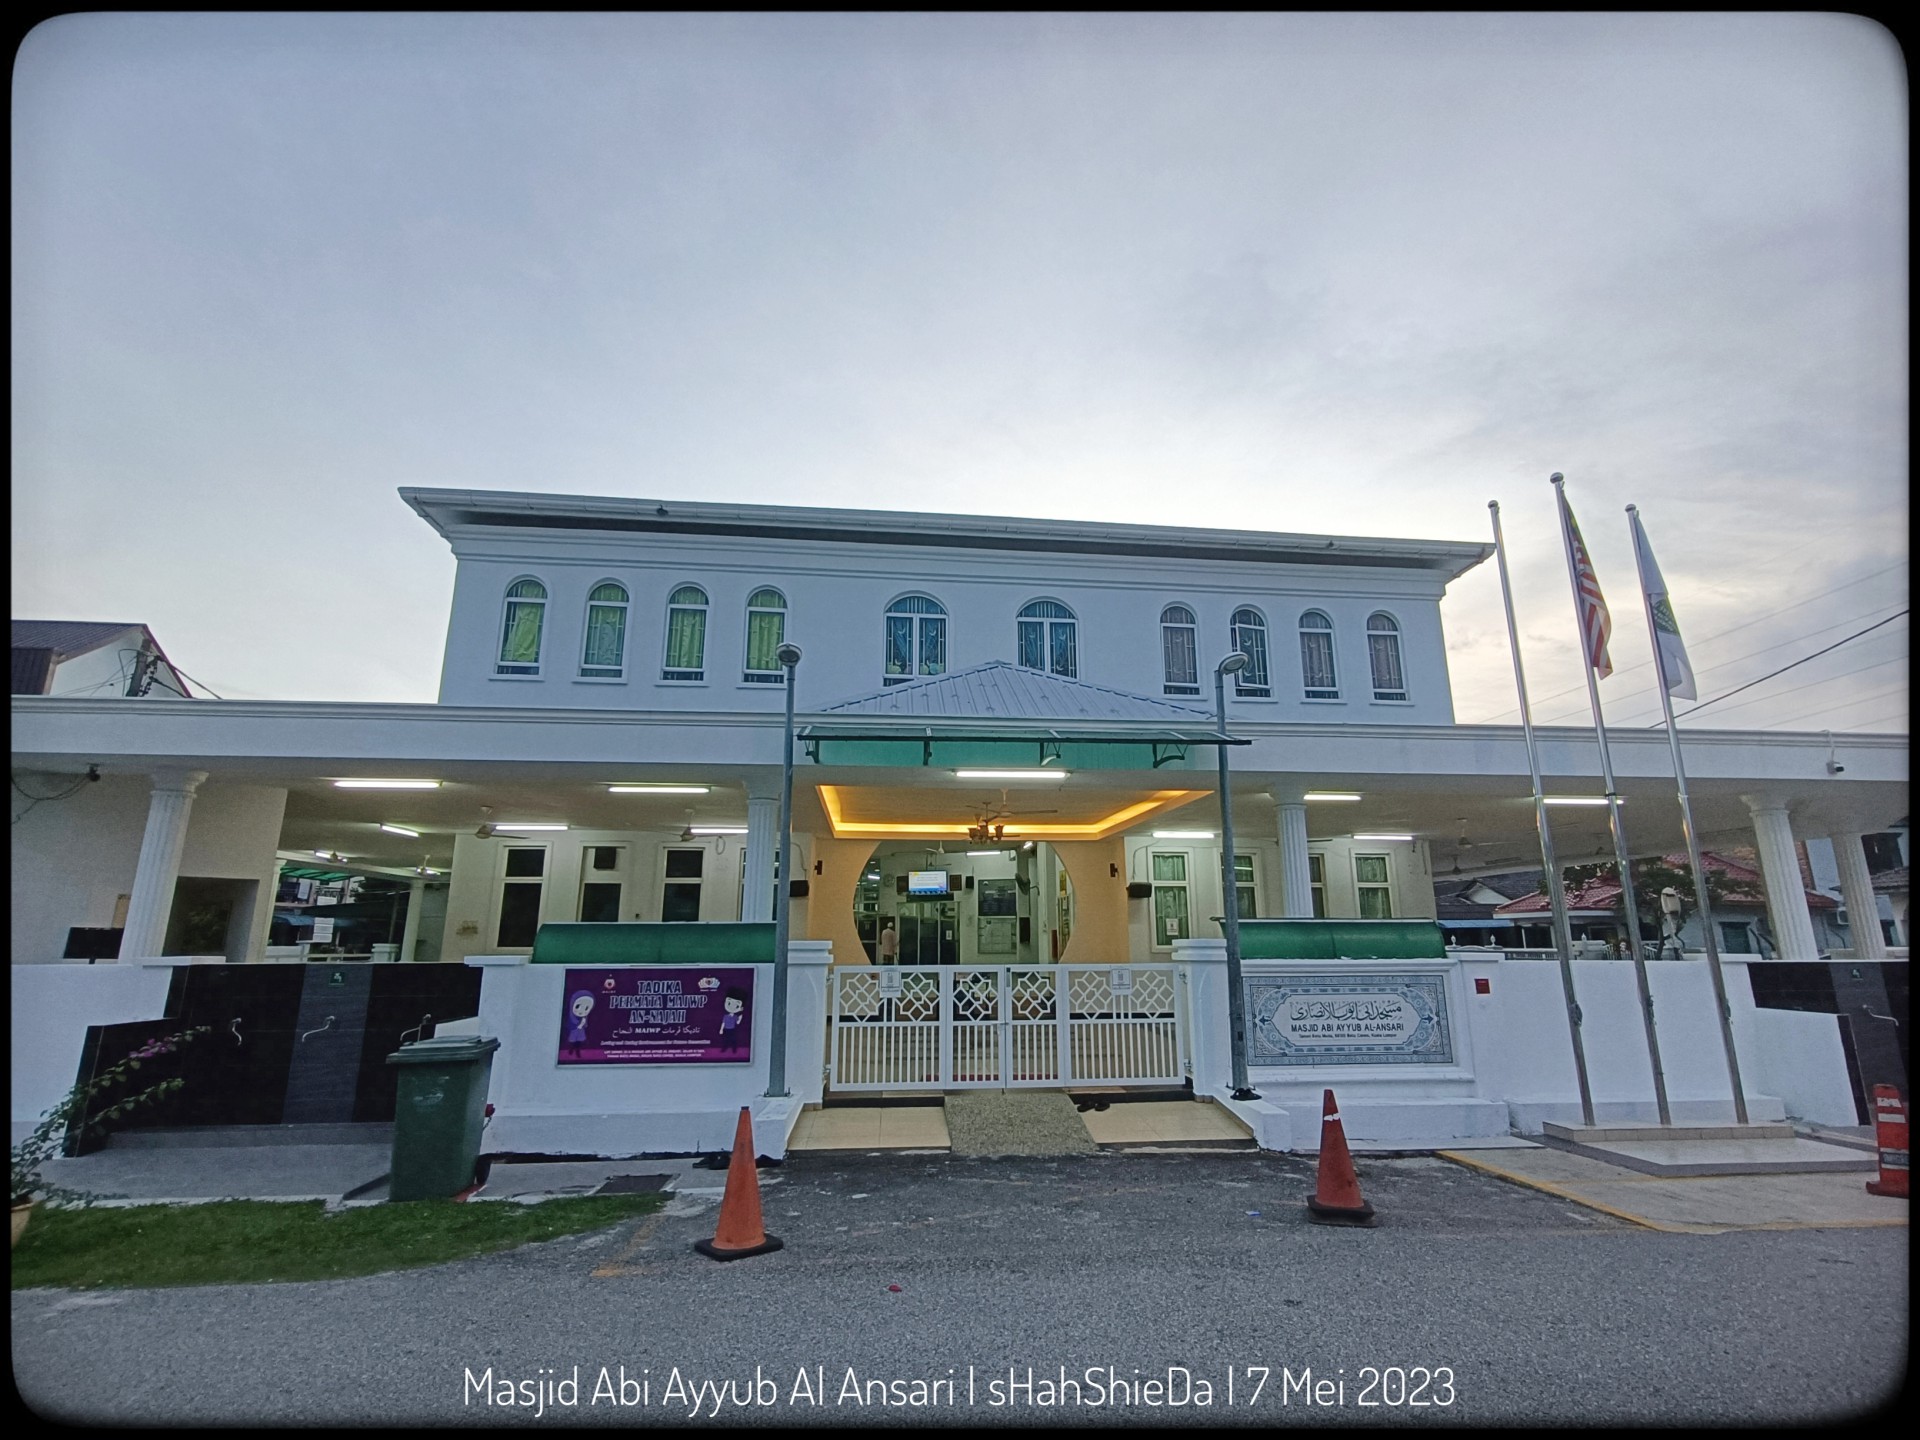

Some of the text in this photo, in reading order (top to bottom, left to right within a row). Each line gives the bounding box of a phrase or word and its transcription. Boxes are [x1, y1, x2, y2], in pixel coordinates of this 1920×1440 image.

[637, 980, 682, 995] TADIKA
[609, 995, 708, 1009] PERMATA MAIWP
[629, 1009, 687, 1025] AN-NAJAH
[1291, 1023, 1405, 1032] MASJID ABI AYYUB AL-ANSARI
